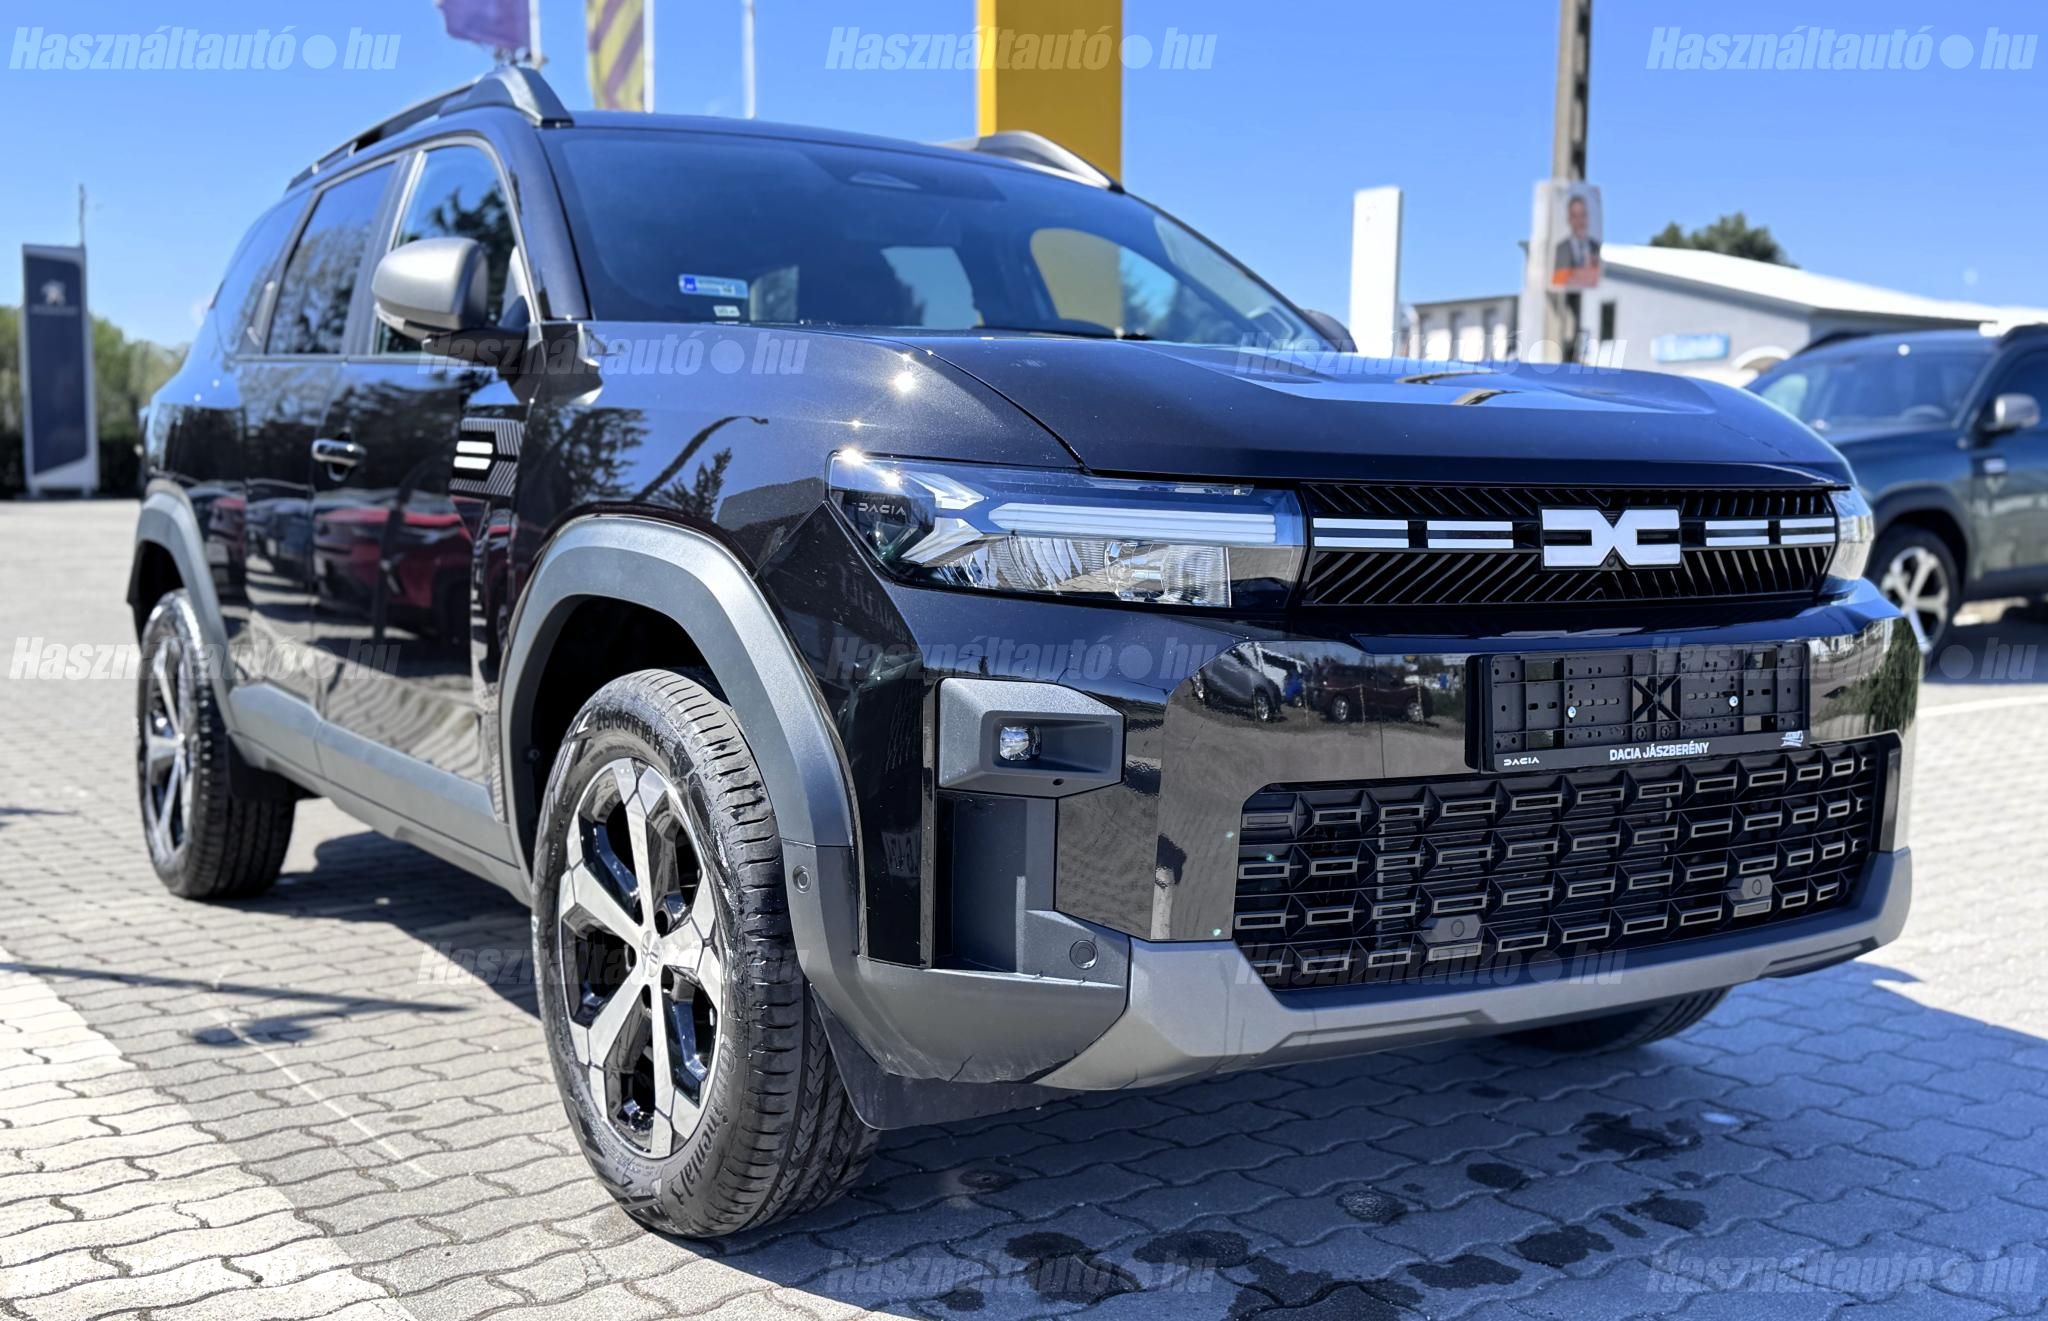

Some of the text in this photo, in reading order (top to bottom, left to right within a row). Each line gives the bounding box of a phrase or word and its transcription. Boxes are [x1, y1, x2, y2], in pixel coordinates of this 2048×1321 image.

[858, 502, 906, 516] DACIA
[1609, 741, 1710, 761] DACIA JÁSZBERÉNY
[1503, 756, 1540, 767] DACIA
